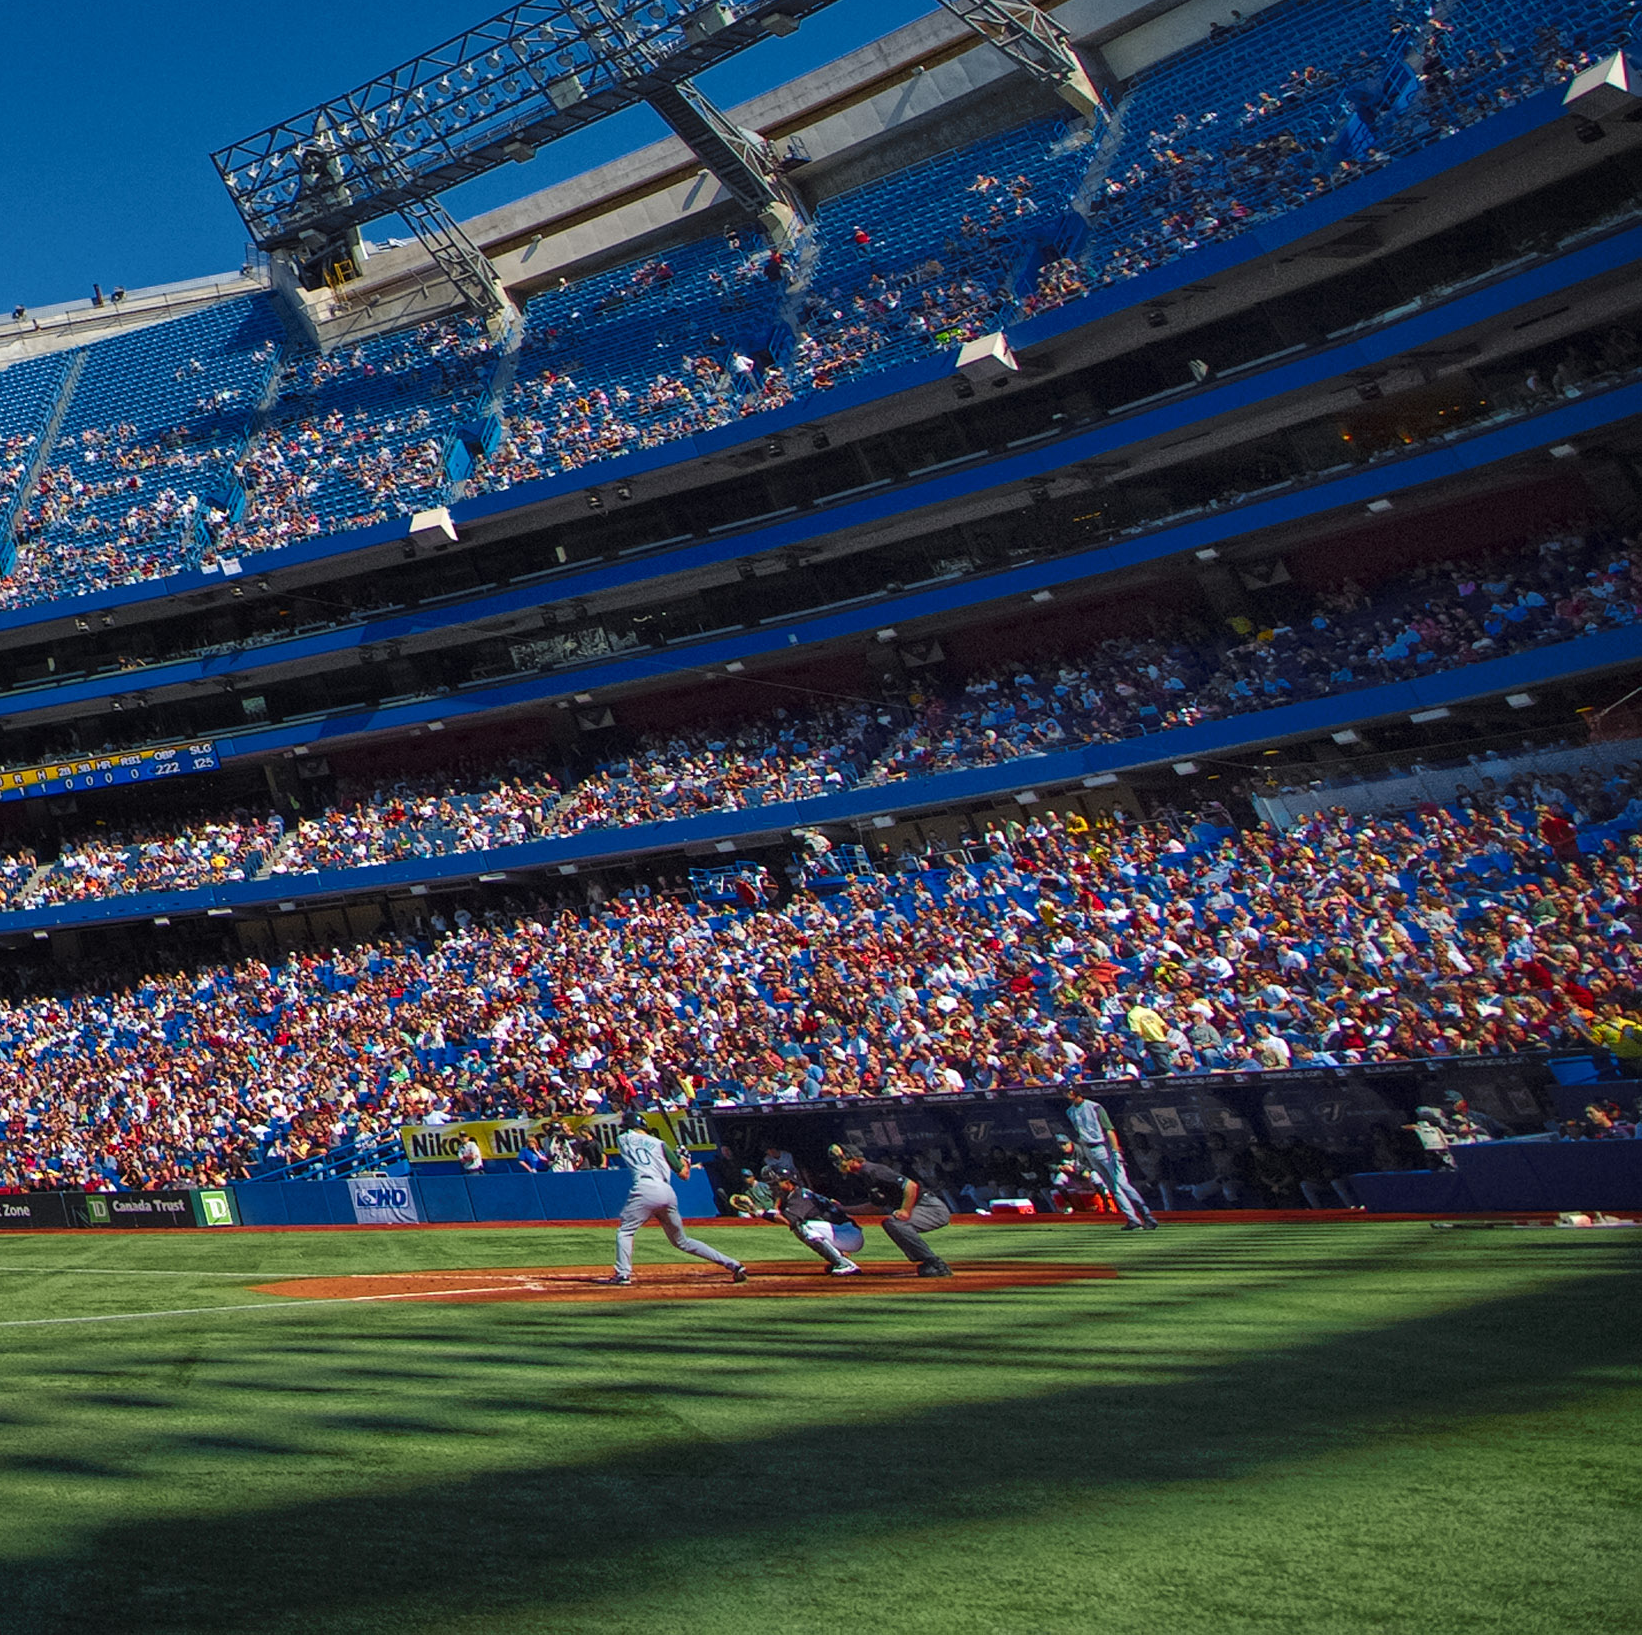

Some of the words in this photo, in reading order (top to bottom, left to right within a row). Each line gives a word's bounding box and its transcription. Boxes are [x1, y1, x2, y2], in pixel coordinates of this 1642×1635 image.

[119, 756, 142, 768] RBI
[187, 743, 213, 756] SLG
[2, 1204, 32, 1218] Zone
[112, 1199, 153, 1213] Canada
[153, 1198, 187, 1213] Trust
